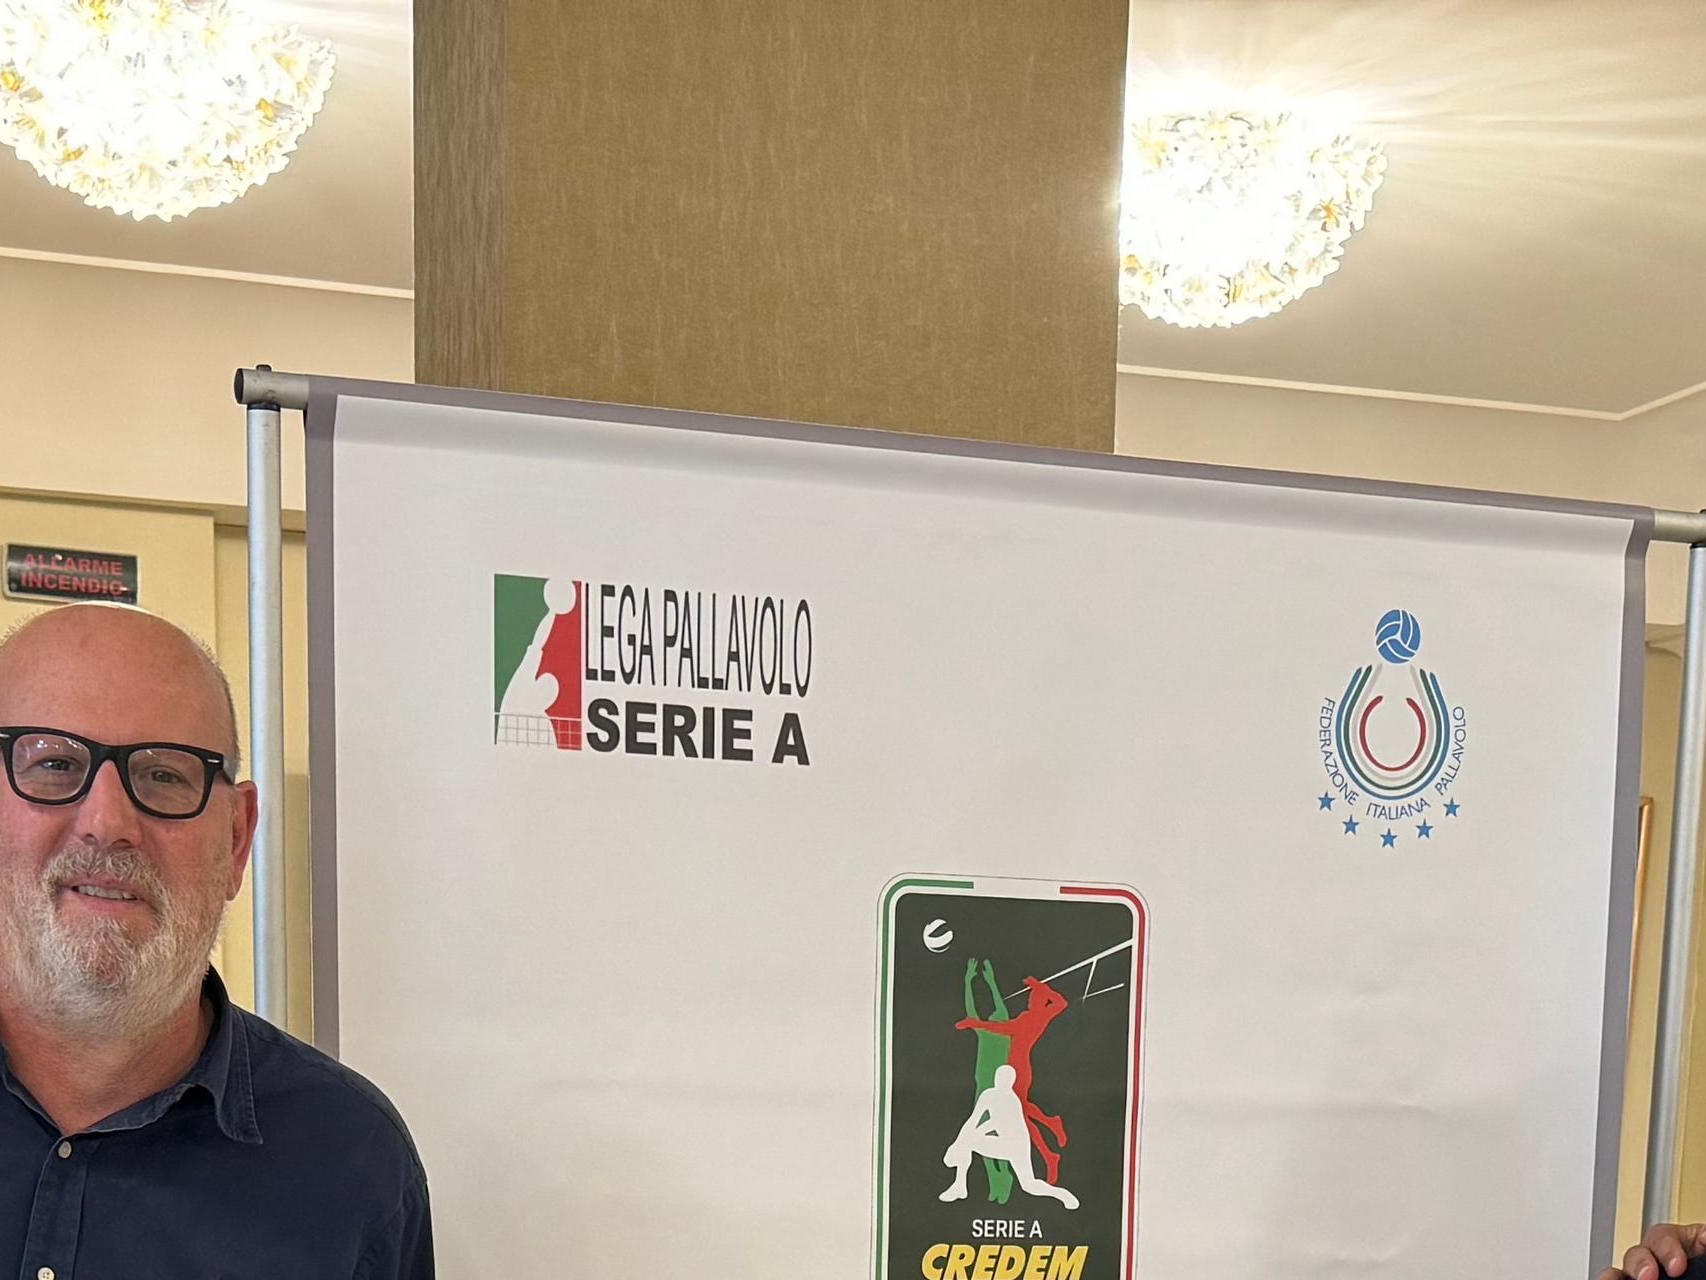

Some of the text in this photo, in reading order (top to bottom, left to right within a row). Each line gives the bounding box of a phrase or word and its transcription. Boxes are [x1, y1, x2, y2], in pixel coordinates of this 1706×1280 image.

[20, 571, 127, 596] INCENDIO
[22, 552, 124, 576] ALLARME
[585, 582, 813, 698] LEGA PALLAVOLO
[585, 697, 811, 767] SERIE A
[1318, 696, 1467, 821] FEDERAZIONE ITALIANA PALLAVOLO
[971, 1218, 1043, 1239] SERIE A
